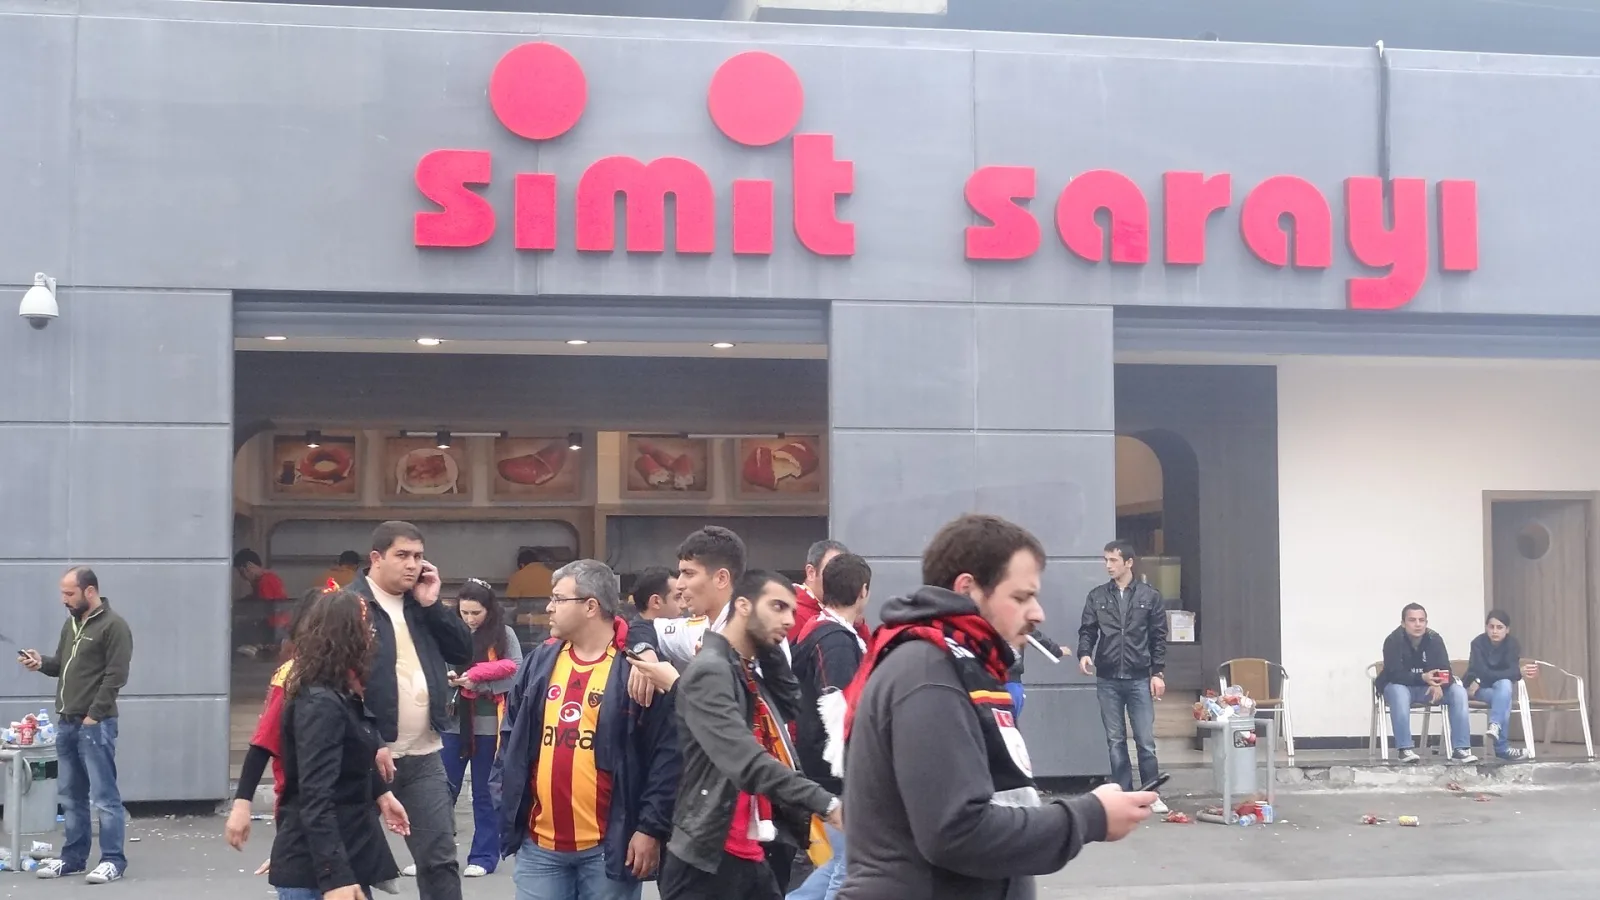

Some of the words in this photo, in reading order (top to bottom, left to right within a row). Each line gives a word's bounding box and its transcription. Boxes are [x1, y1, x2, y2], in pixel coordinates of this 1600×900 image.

[414, 42, 855, 256] simit
[964, 165, 1479, 310] sarayı
[543, 725, 596, 750] avea
